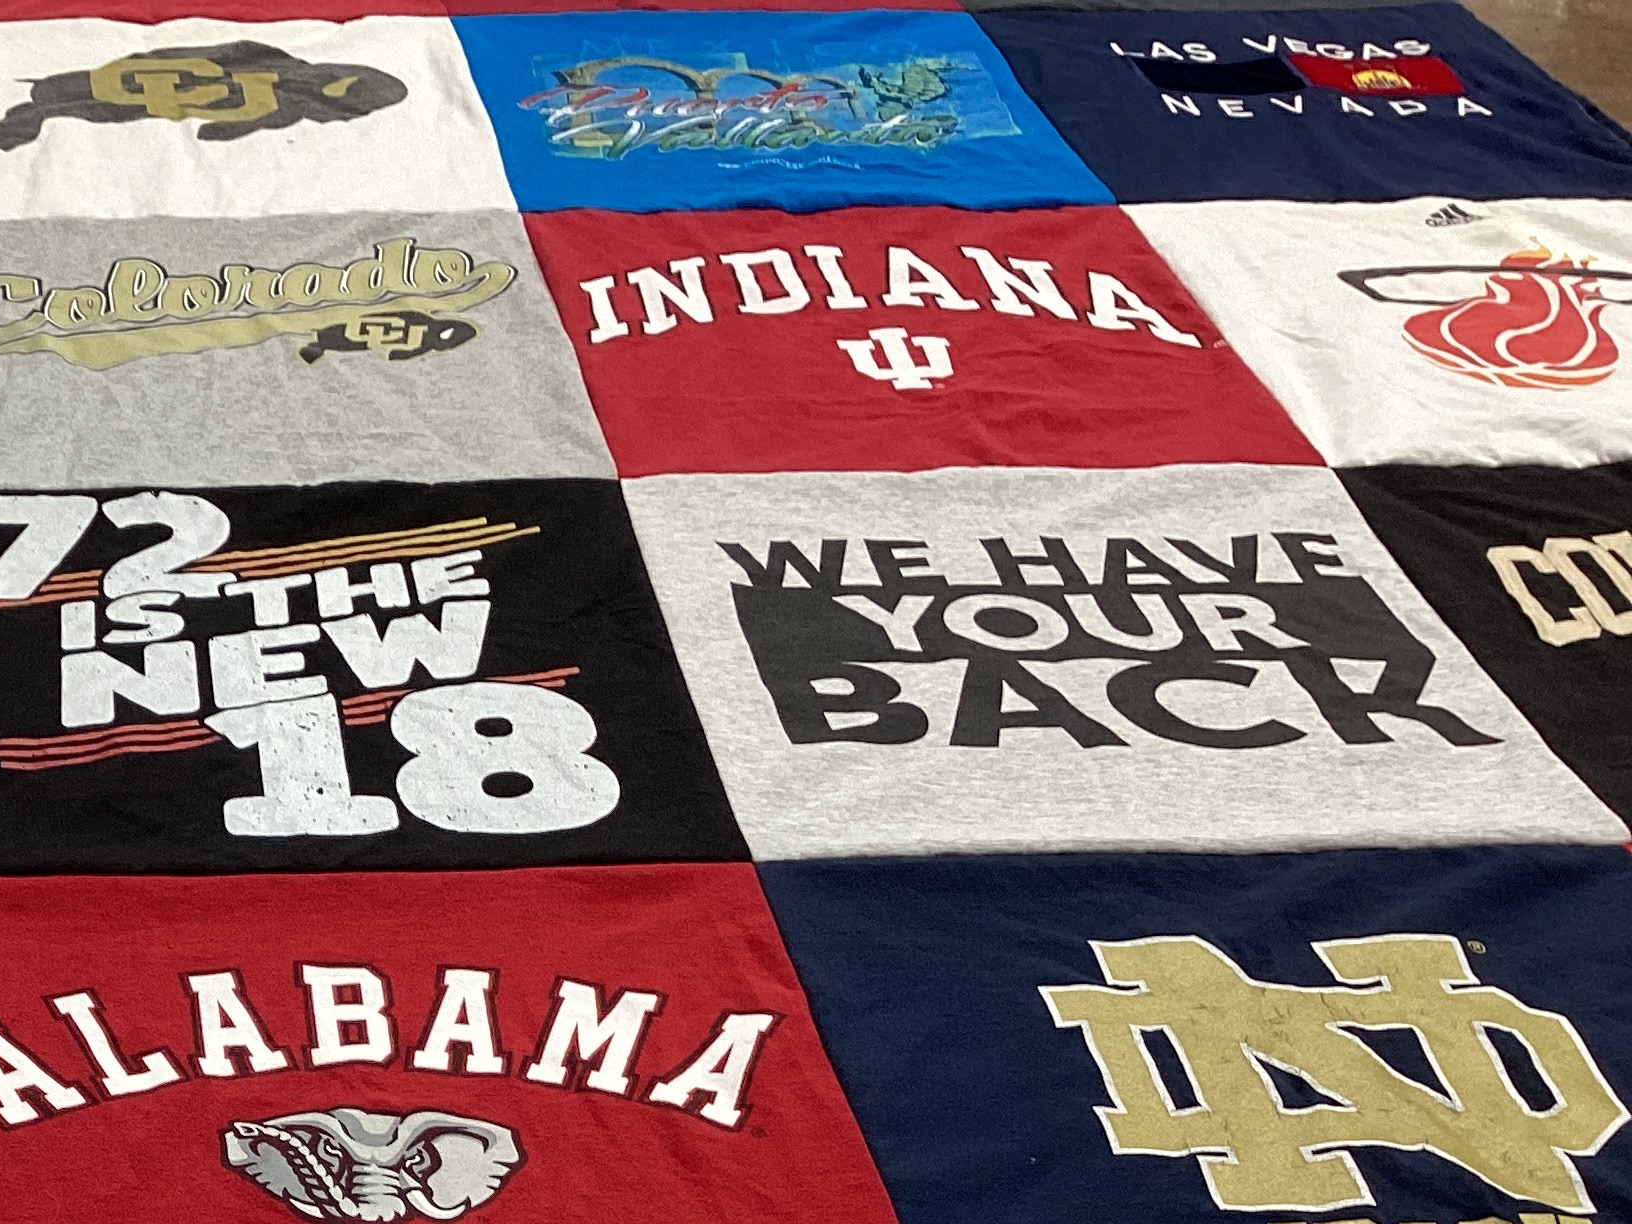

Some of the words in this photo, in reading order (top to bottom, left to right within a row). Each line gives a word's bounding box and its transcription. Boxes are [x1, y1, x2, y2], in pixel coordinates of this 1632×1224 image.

[1110, 41, 1217, 62] LAS
[1242, 35, 1431, 61] VEGAS
[1161, 93, 1493, 118] NEVADA
[579, 245, 1203, 348] INDIANA
[61, 591, 186, 650] IS
[225, 549, 490, 627] THE
[715, 538, 950, 588] WE
[979, 532, 1368, 585] HAVE
[1486, 530, 1632, 647] CO
[61, 600, 491, 728] NEW
[832, 592, 1311, 653] YOUR
[780, 656, 1506, 749] BACK
[203, 680, 621, 837] 18
